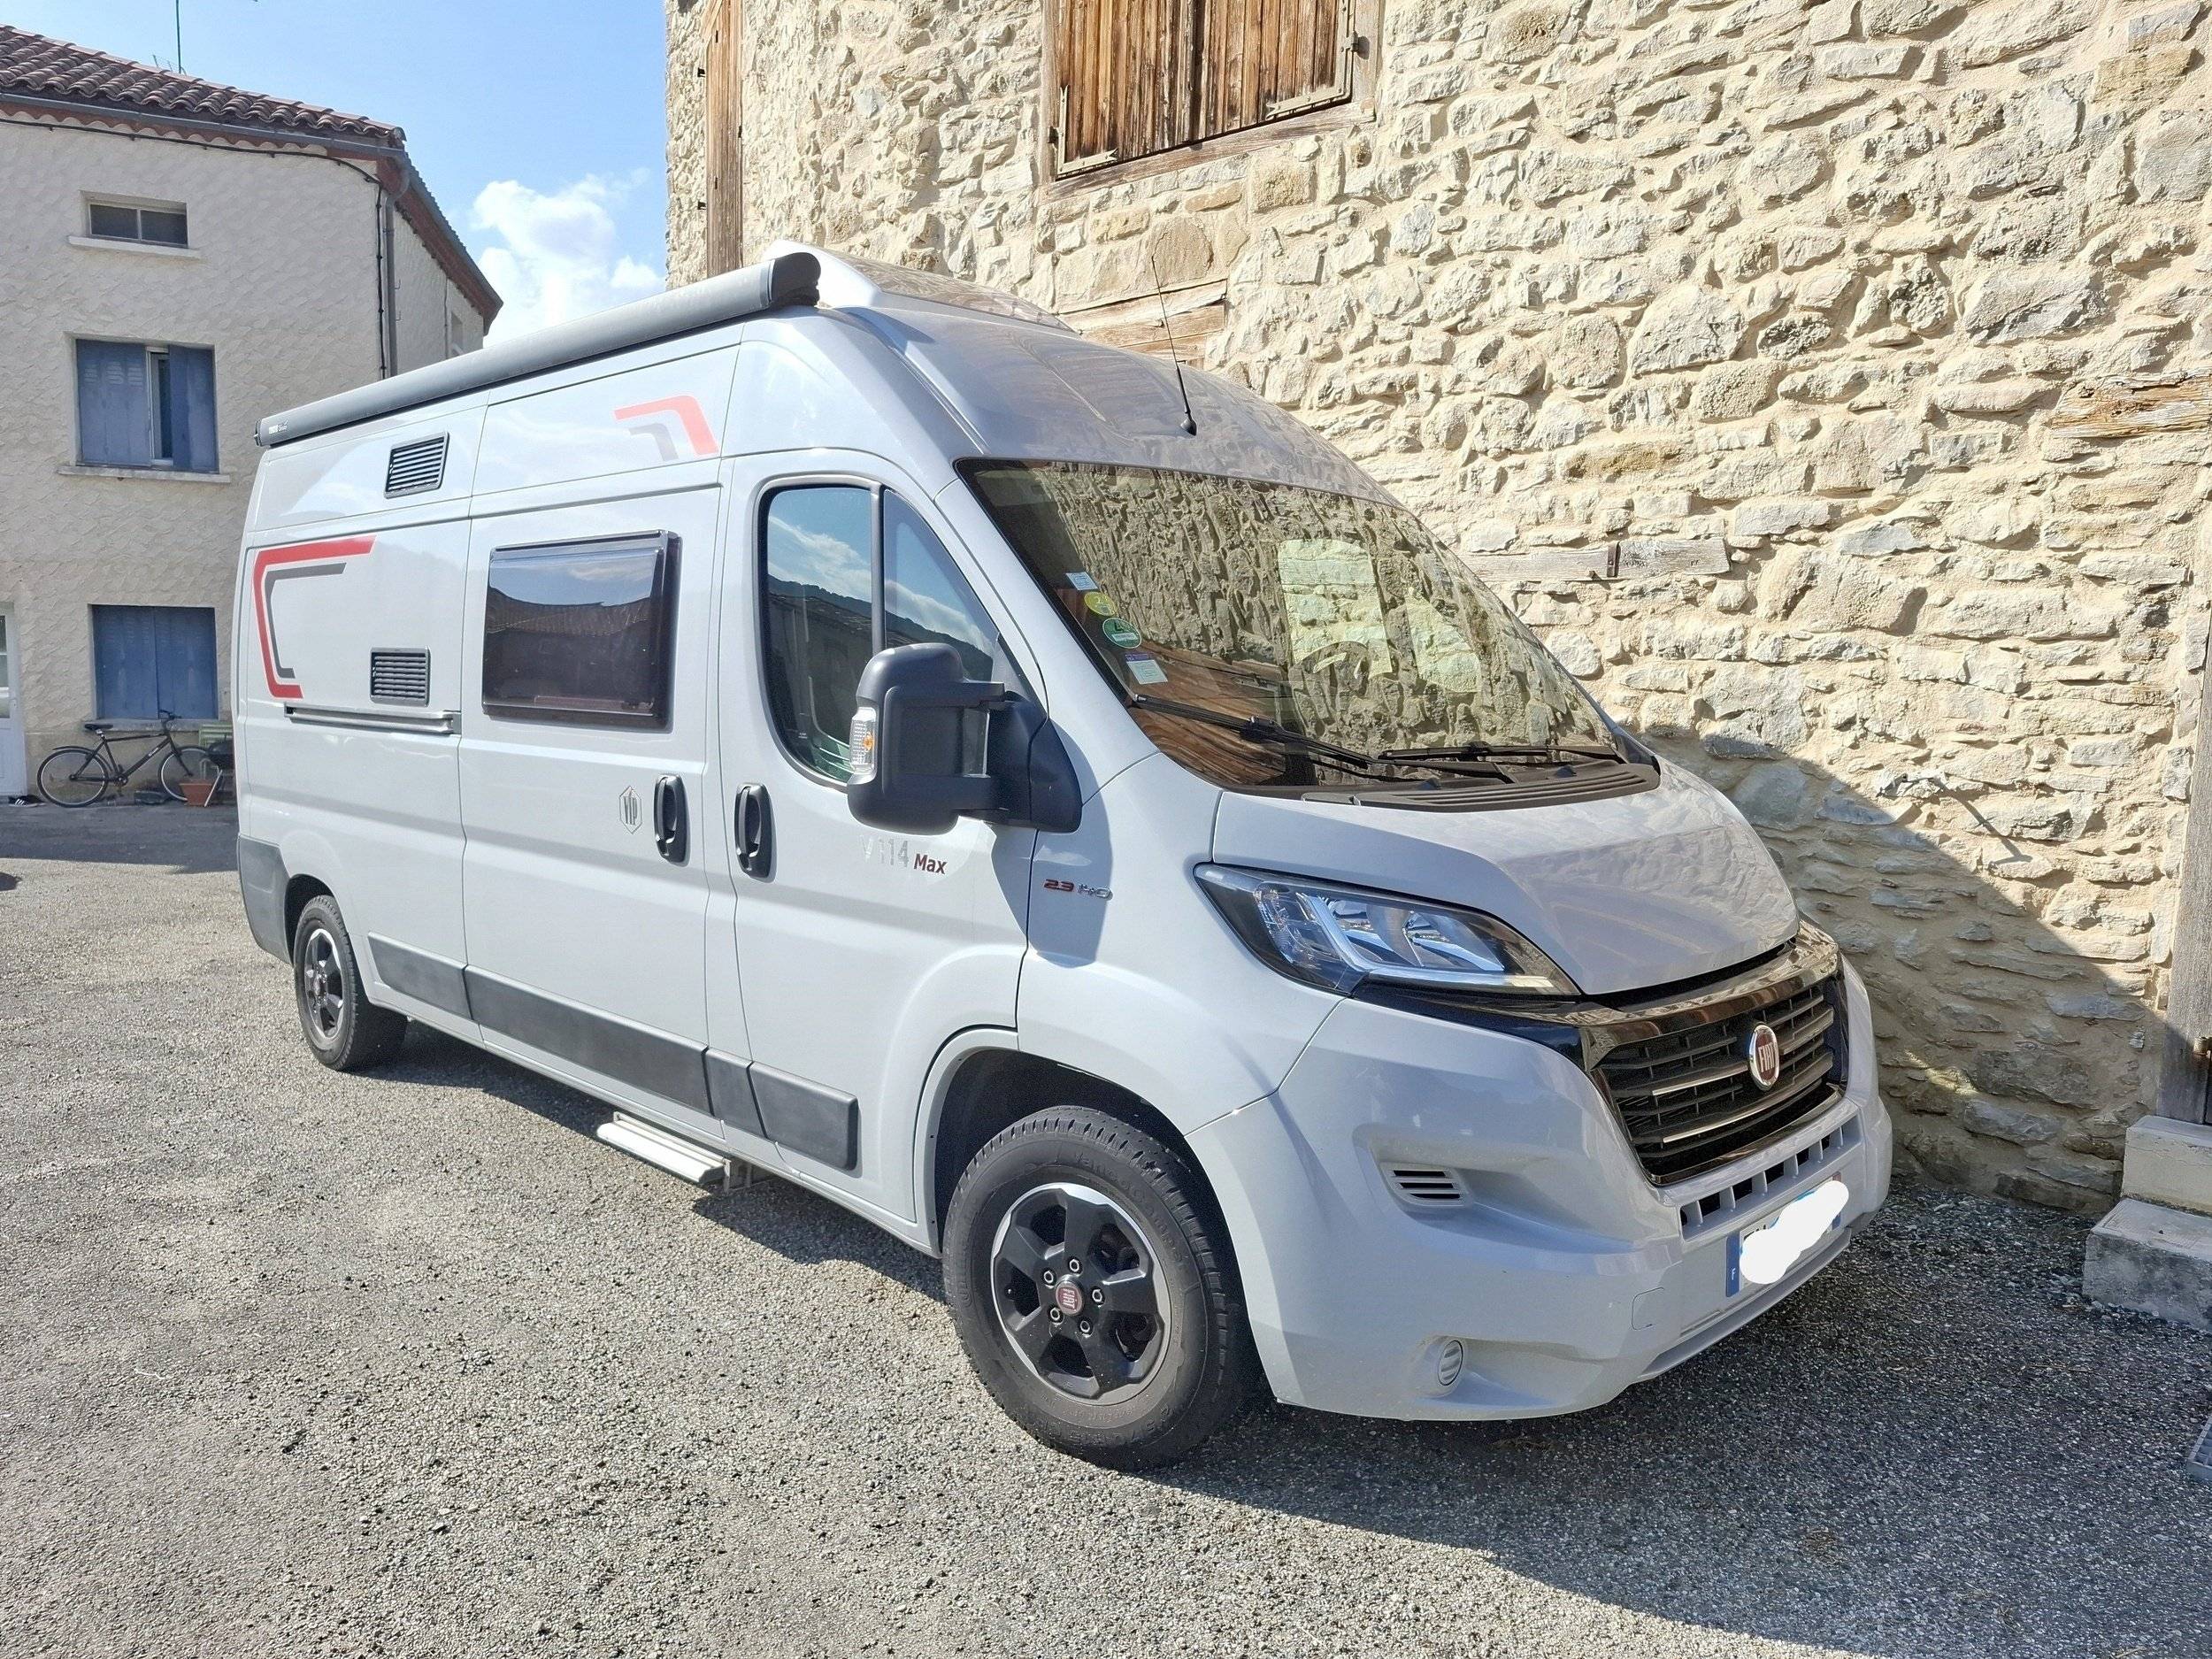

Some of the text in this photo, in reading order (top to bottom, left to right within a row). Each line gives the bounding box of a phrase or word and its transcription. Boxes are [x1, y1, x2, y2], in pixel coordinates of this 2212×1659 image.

[913, 853, 948, 875] Max
[1757, 1041, 1776, 1073] FIAT
[1730, 1267, 1737, 1281] F
[1062, 1288, 1077, 1310] FIAT
